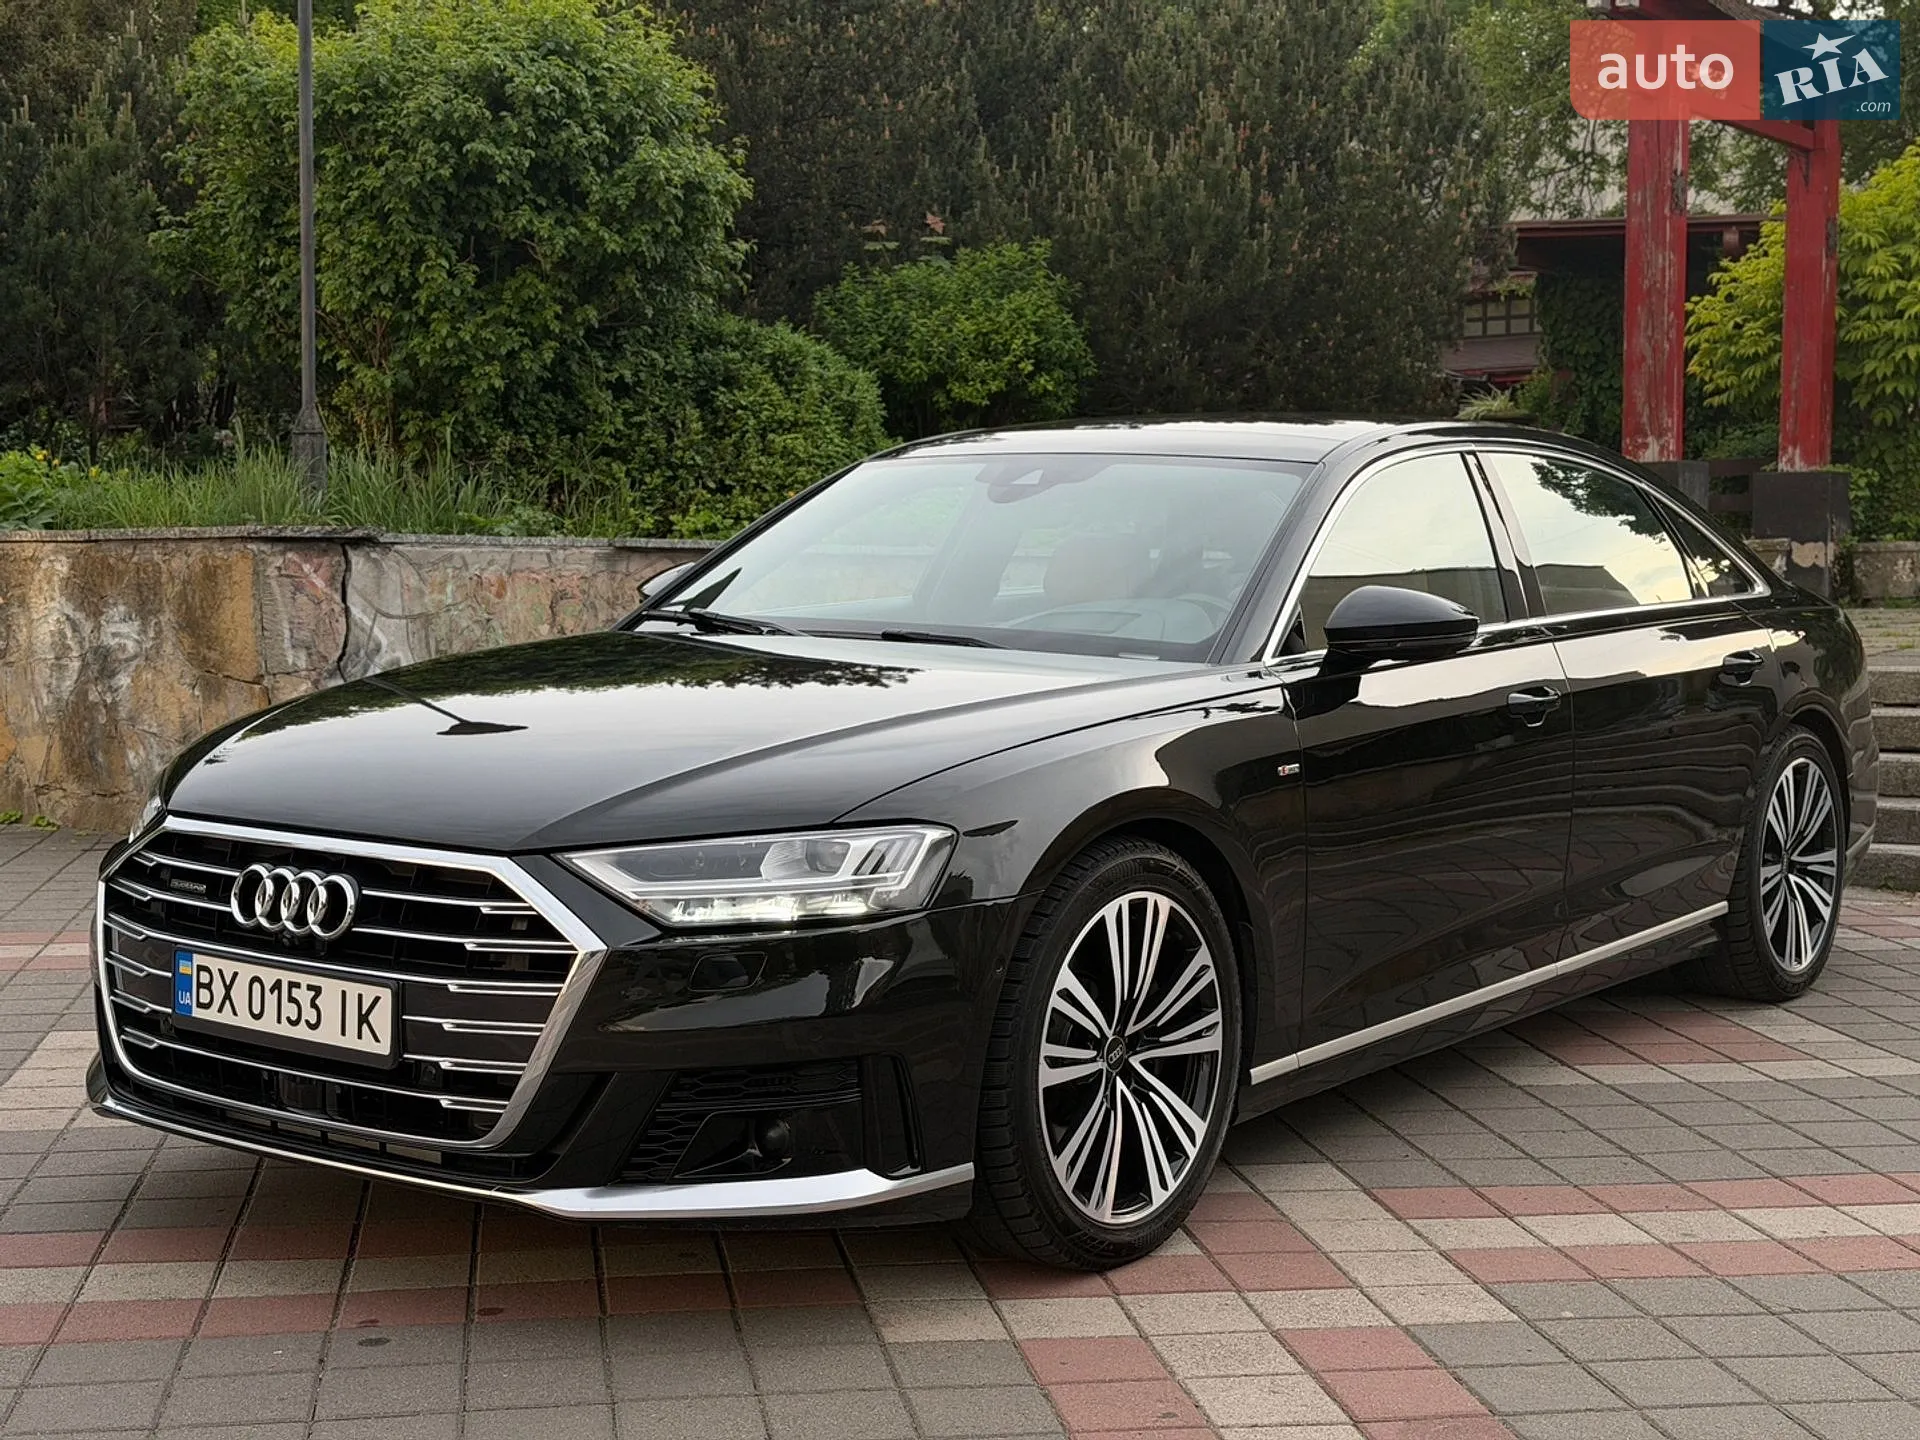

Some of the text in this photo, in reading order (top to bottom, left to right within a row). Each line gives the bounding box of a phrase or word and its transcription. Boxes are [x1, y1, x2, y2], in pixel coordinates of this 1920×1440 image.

[178, 990, 192, 1006] UA
[196, 964, 382, 1044] BX 0153 IK
